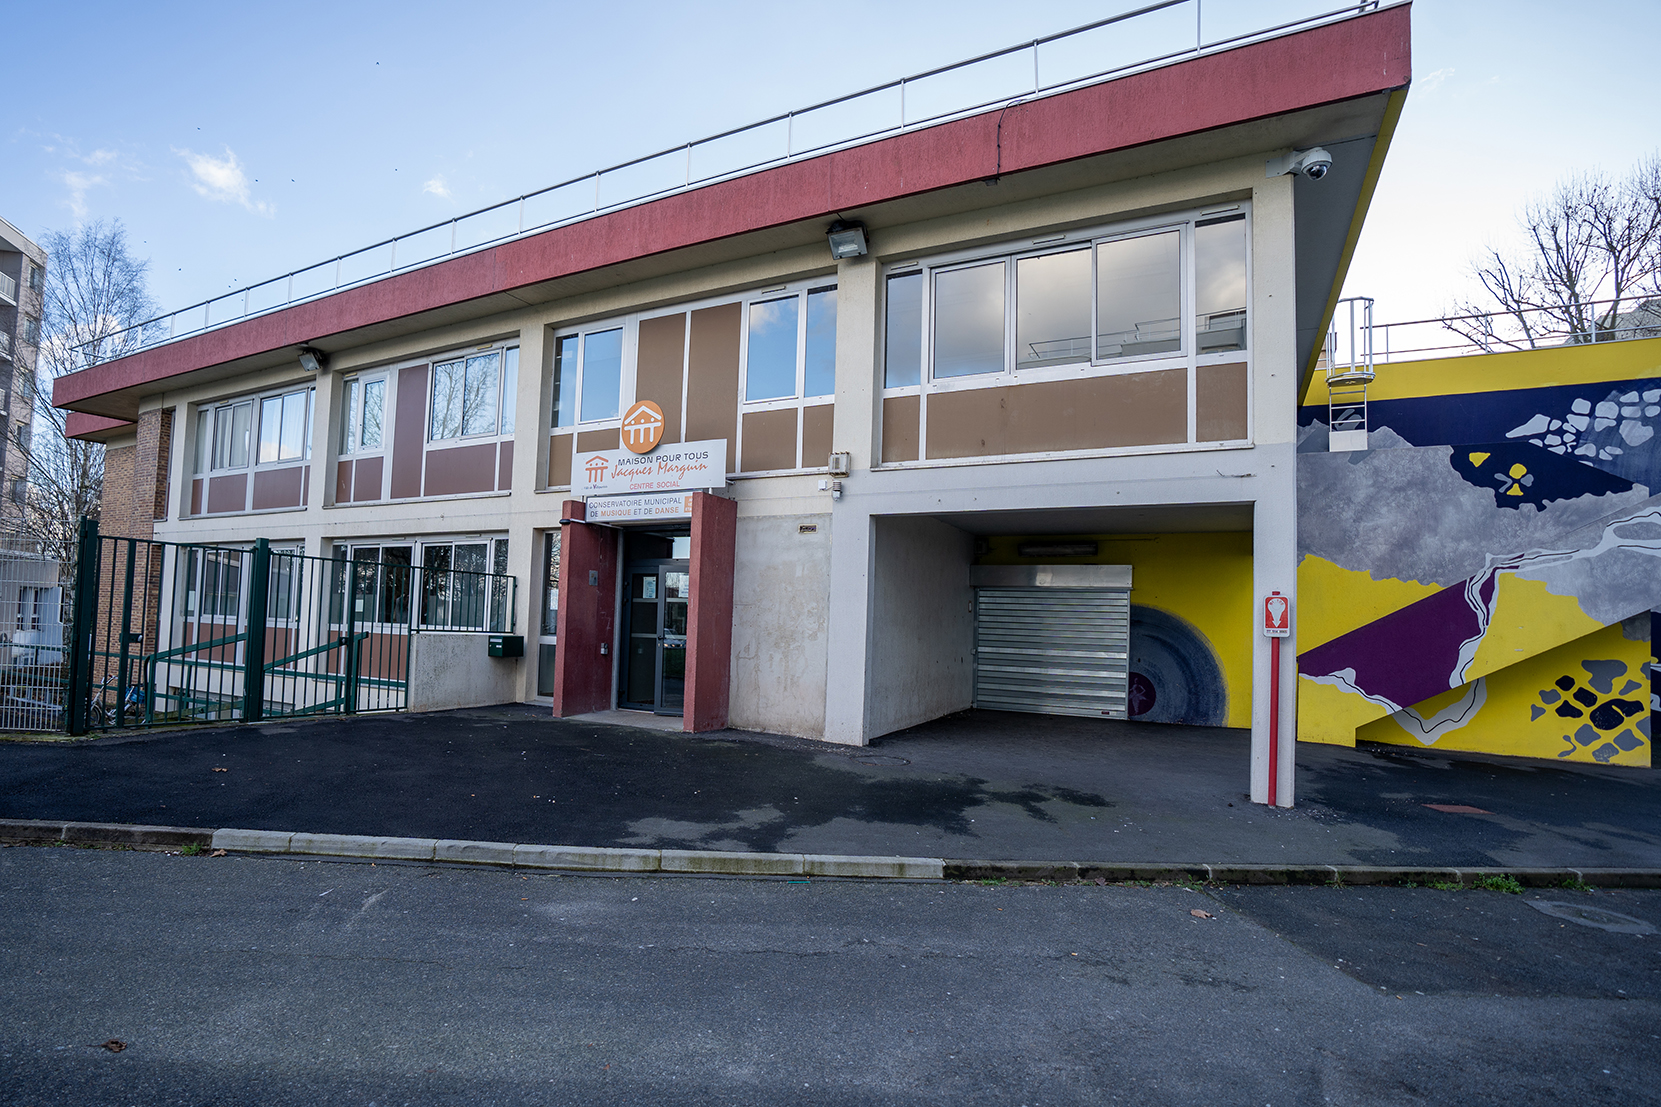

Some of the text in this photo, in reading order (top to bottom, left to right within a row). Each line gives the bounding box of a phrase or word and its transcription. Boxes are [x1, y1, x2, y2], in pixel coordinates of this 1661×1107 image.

[617, 451, 709, 466] MAISON POUR TOUS
[611, 464, 653, 482] Jacques
[629, 480, 680, 490] CENTRE SOCIAL
[588, 499, 642, 509] CONSERVATOIRE
[643, 497, 682, 506] MUNICIPAL
[590, 506, 679, 518] DE MUSIQUE ET DE DANSE
